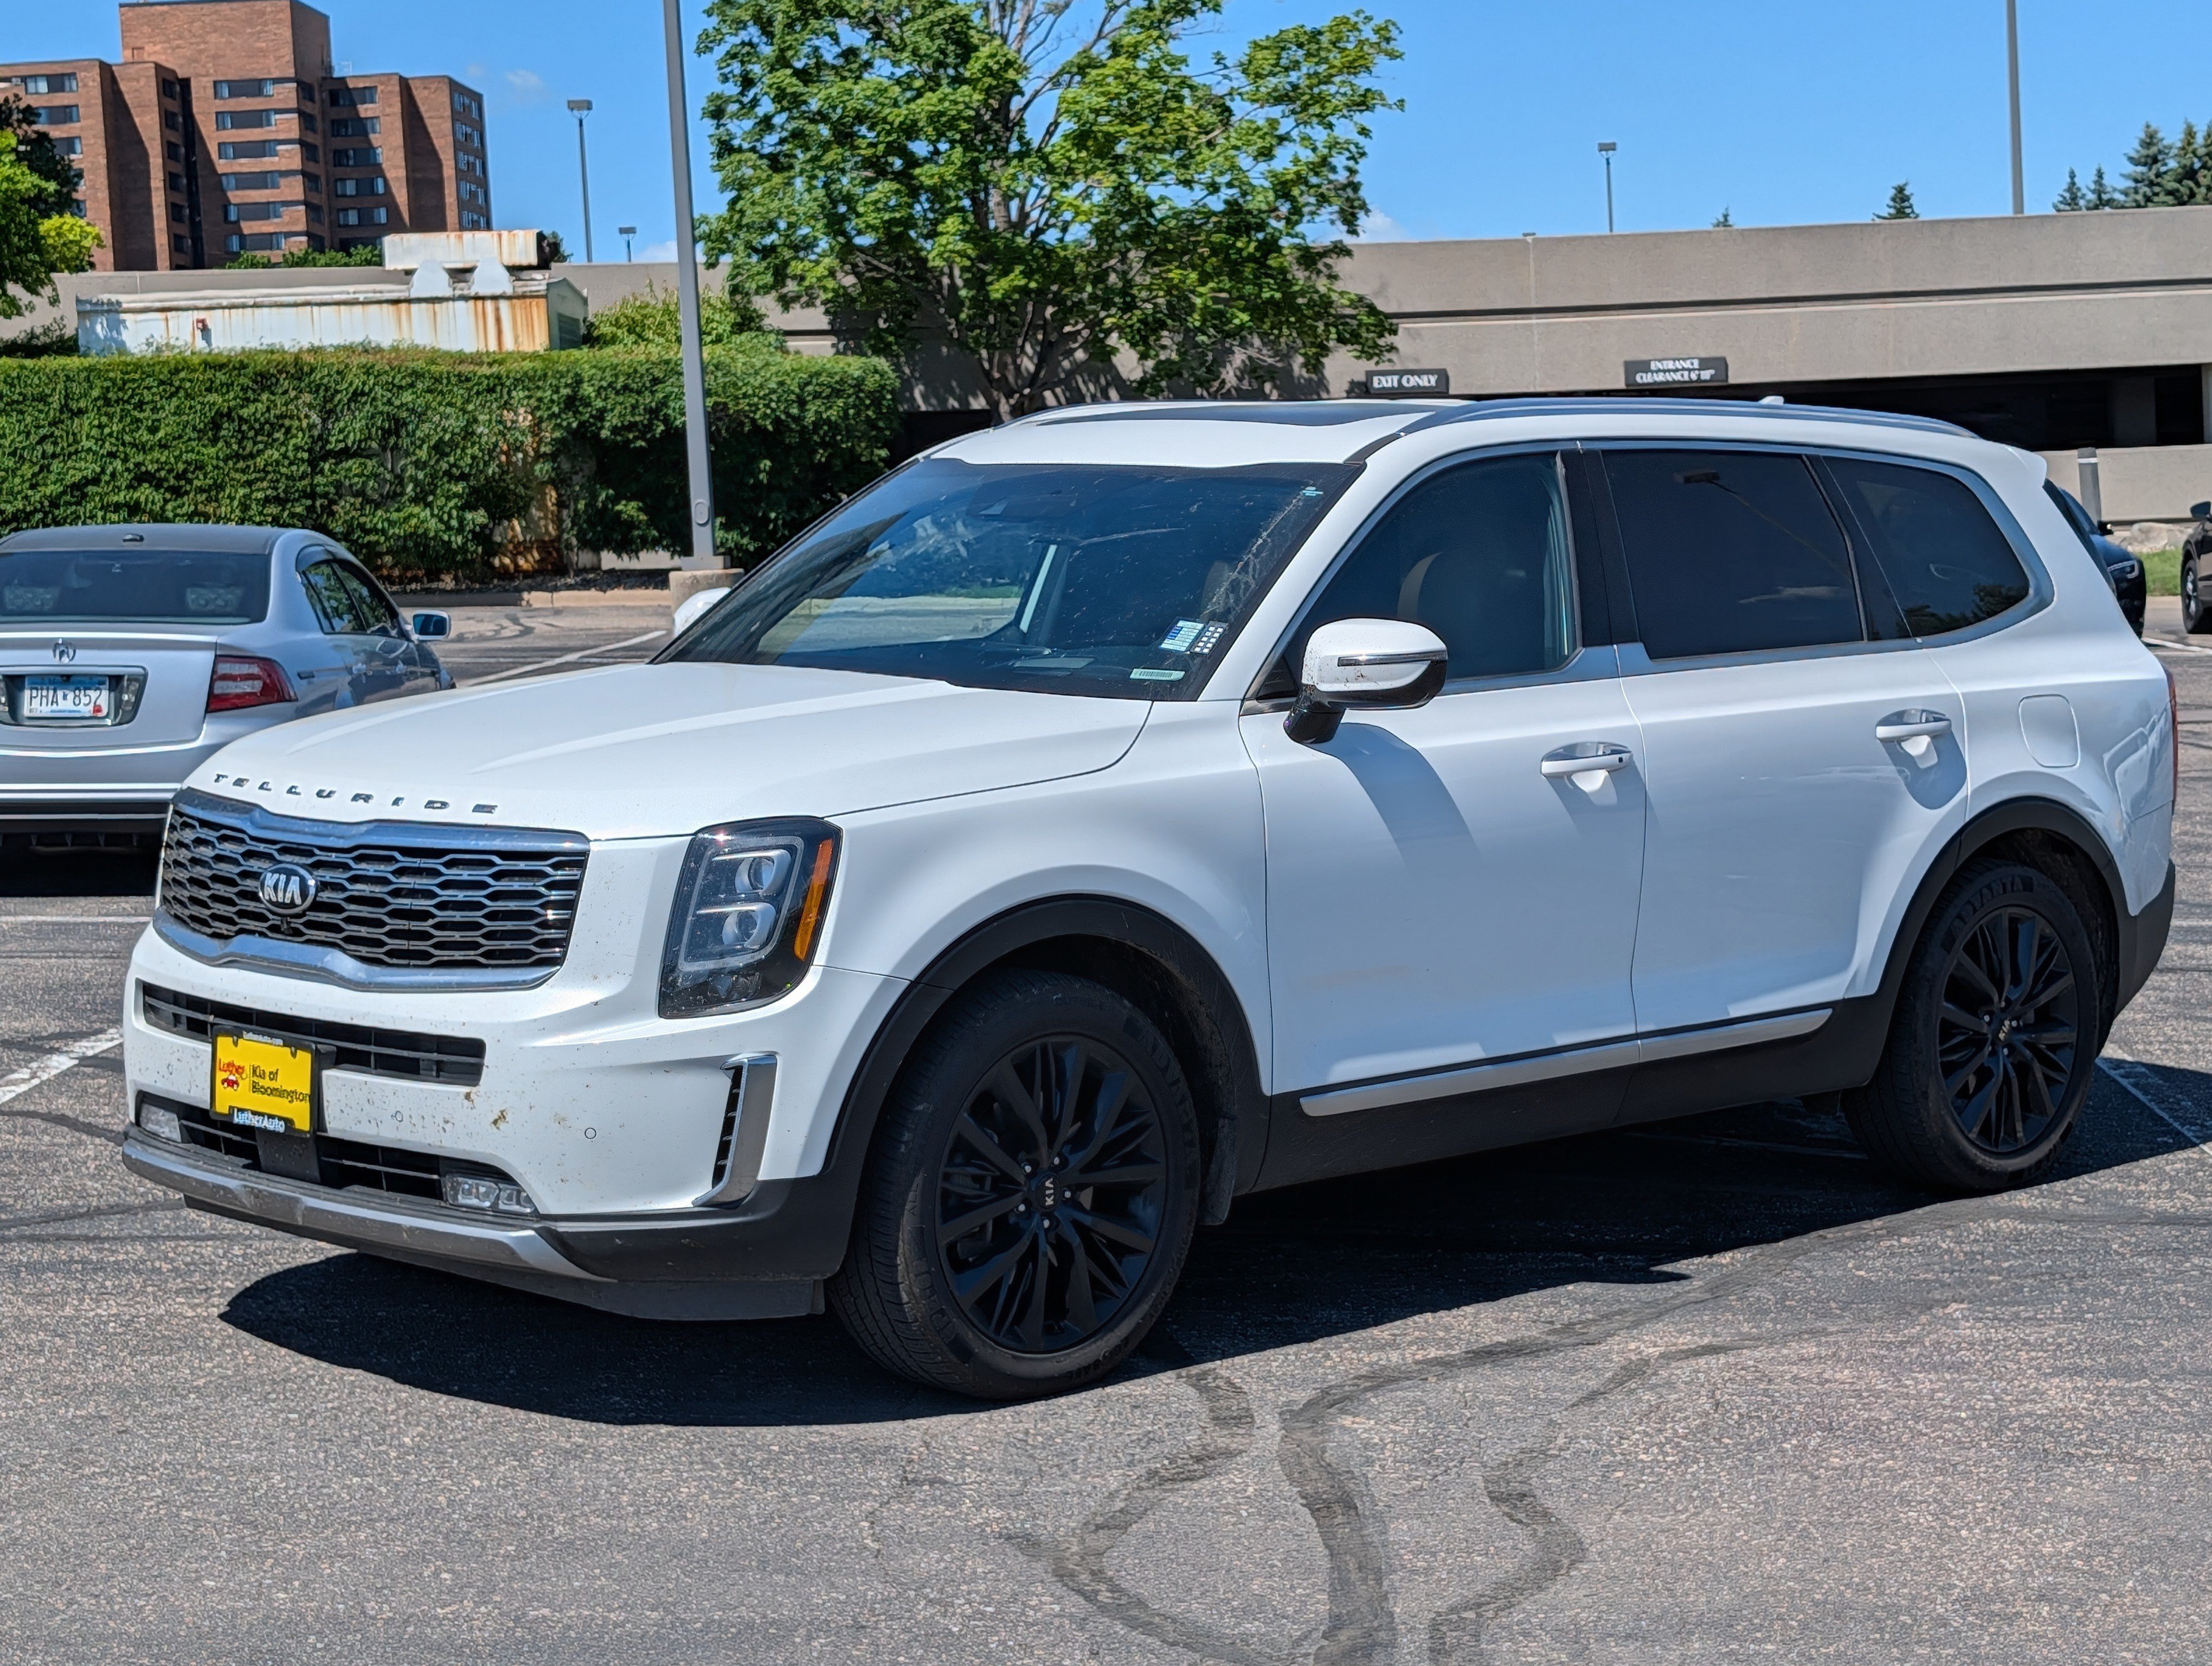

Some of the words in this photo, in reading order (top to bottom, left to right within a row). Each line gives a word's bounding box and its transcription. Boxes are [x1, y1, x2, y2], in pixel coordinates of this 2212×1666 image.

[1650, 358, 1699, 371] ENTRANCE
[1372, 375, 1400, 388] EXIT
[1401, 374, 1438, 387] ONLY
[1635, 370, 1689, 383] CLEARANCE
[29, 686, 59, 707] PHA
[73, 686, 102, 707] 852
[214, 773, 498, 815] TELLURIDE
[264, 872, 302, 906] KIA
[252, 1063, 266, 1080] Kia
[268, 1068, 279, 1082] of
[251, 1080, 310, 1104] Bloomington
[1045, 1177, 1054, 1207] KIA
